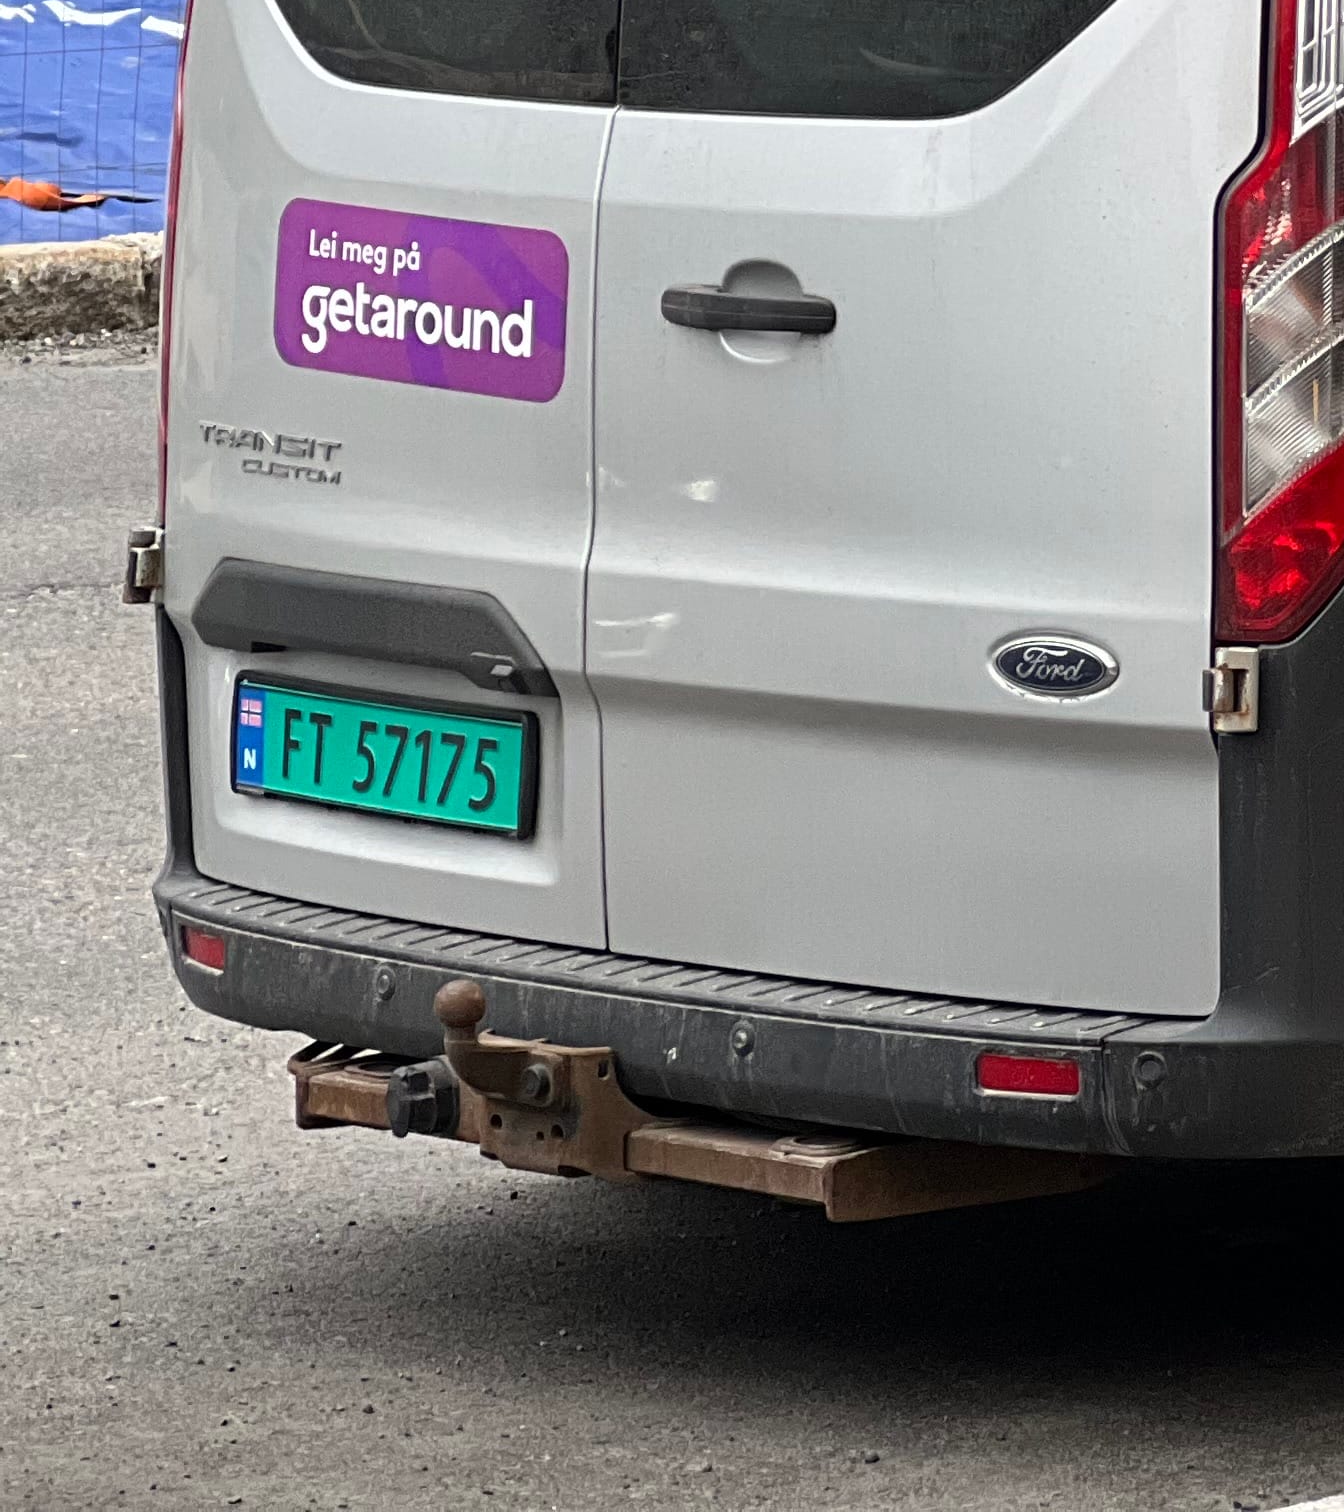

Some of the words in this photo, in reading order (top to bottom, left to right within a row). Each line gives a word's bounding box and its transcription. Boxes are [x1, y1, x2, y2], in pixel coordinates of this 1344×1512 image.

[308, 229, 337, 259] Lei
[341, 242, 387, 275] meg
[393, 241, 421, 277] på
[301, 282, 534, 358] getaround
[199, 420, 343, 462] TRANSIT
[241, 459, 343, 486] CUSTOM
[1015, 646, 1085, 682] Ford
[243, 747, 257, 770] N
[282, 708, 333, 785] FT
[352, 720, 498, 811] 57175
